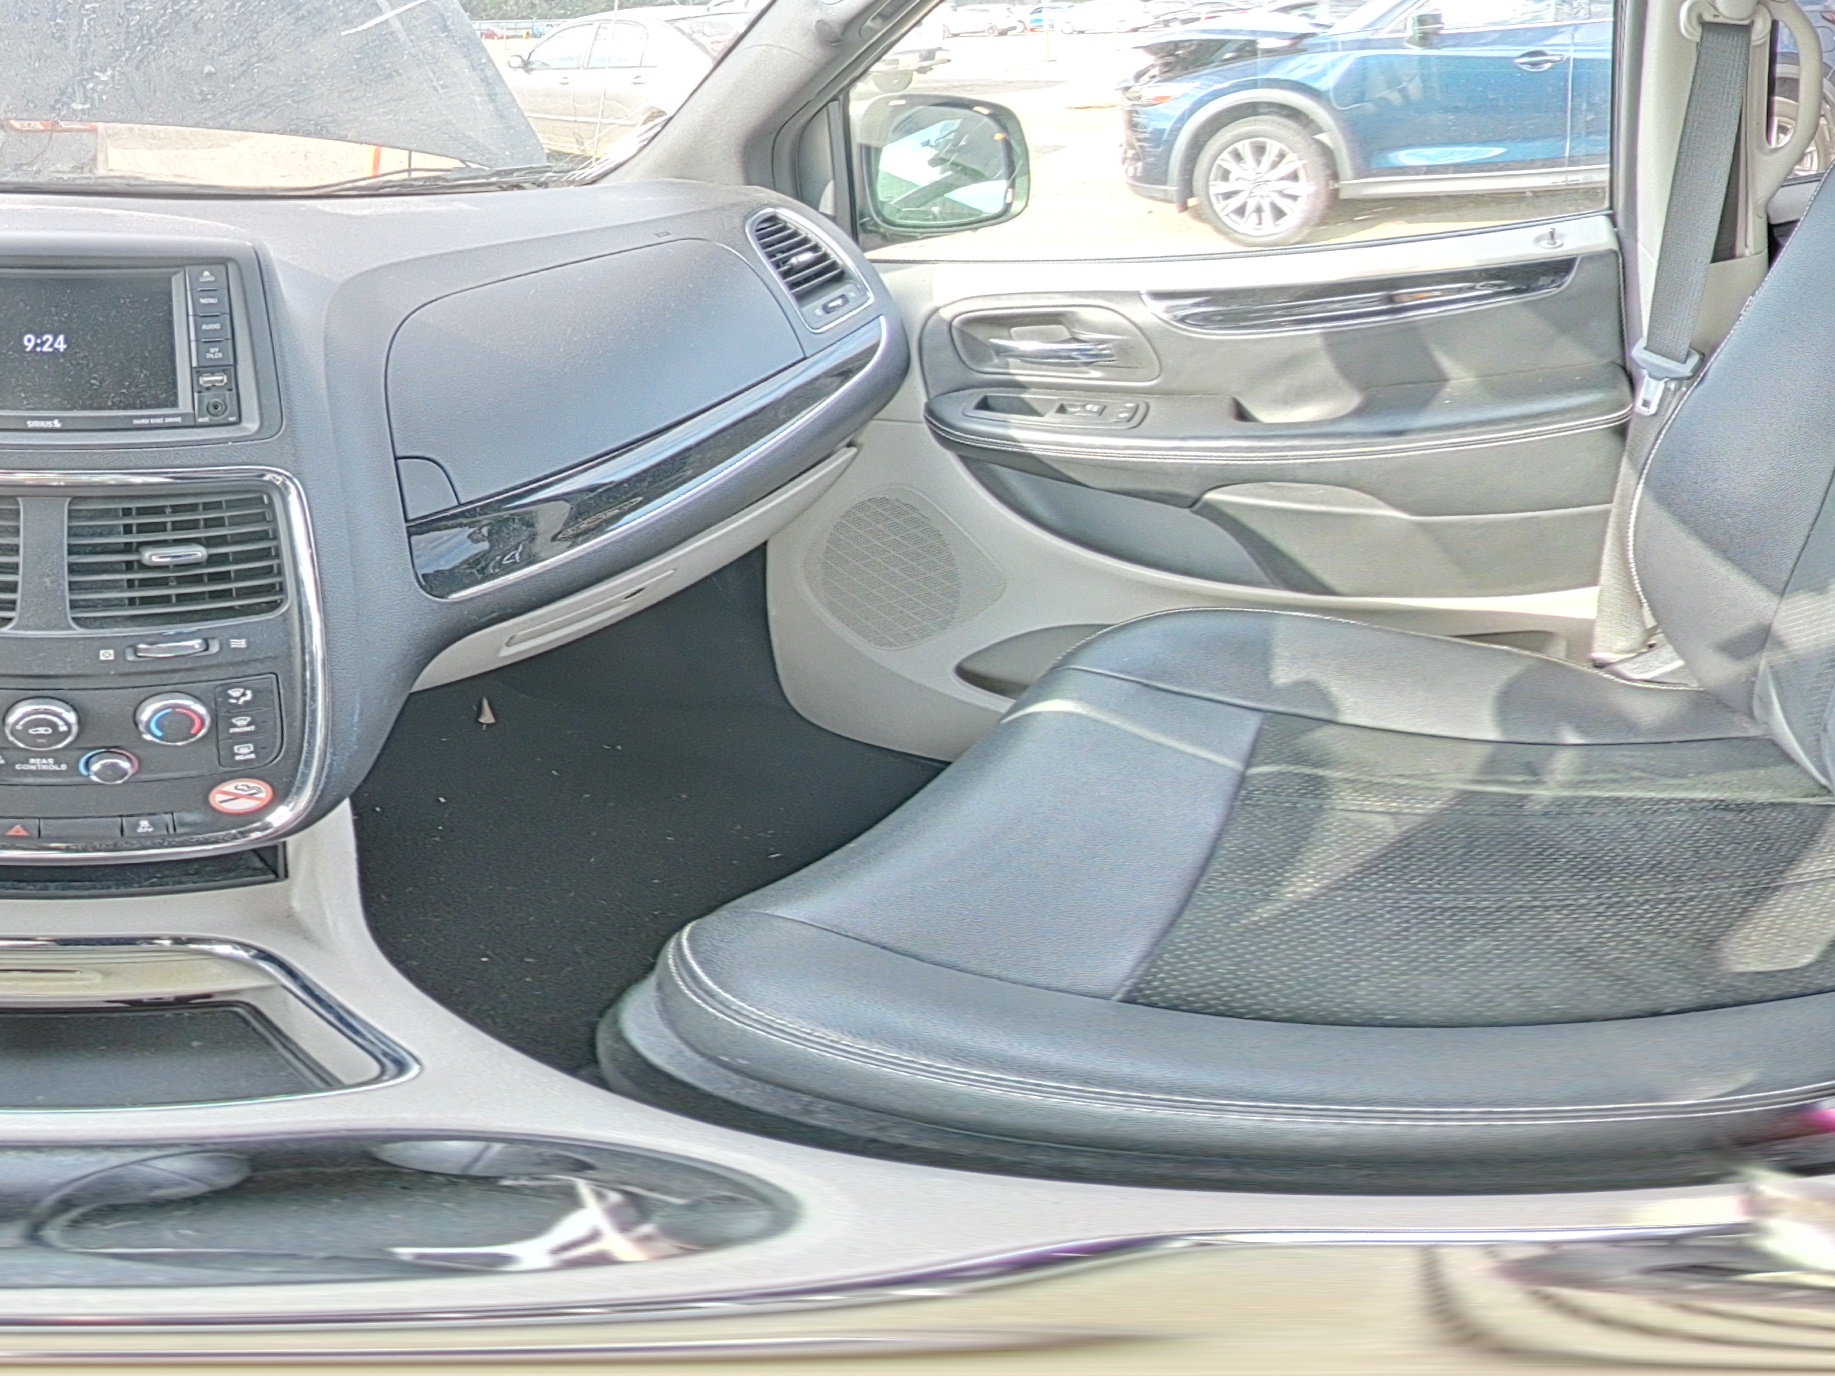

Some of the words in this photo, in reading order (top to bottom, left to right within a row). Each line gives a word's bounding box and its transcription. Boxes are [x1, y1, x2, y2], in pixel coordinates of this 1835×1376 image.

[23, 334, 67, 353] 9:24
[27, 420, 53, 428] SIRIUS
[229, 725, 255, 733] FRONT
[15, 763, 68, 771] CONTROLS
